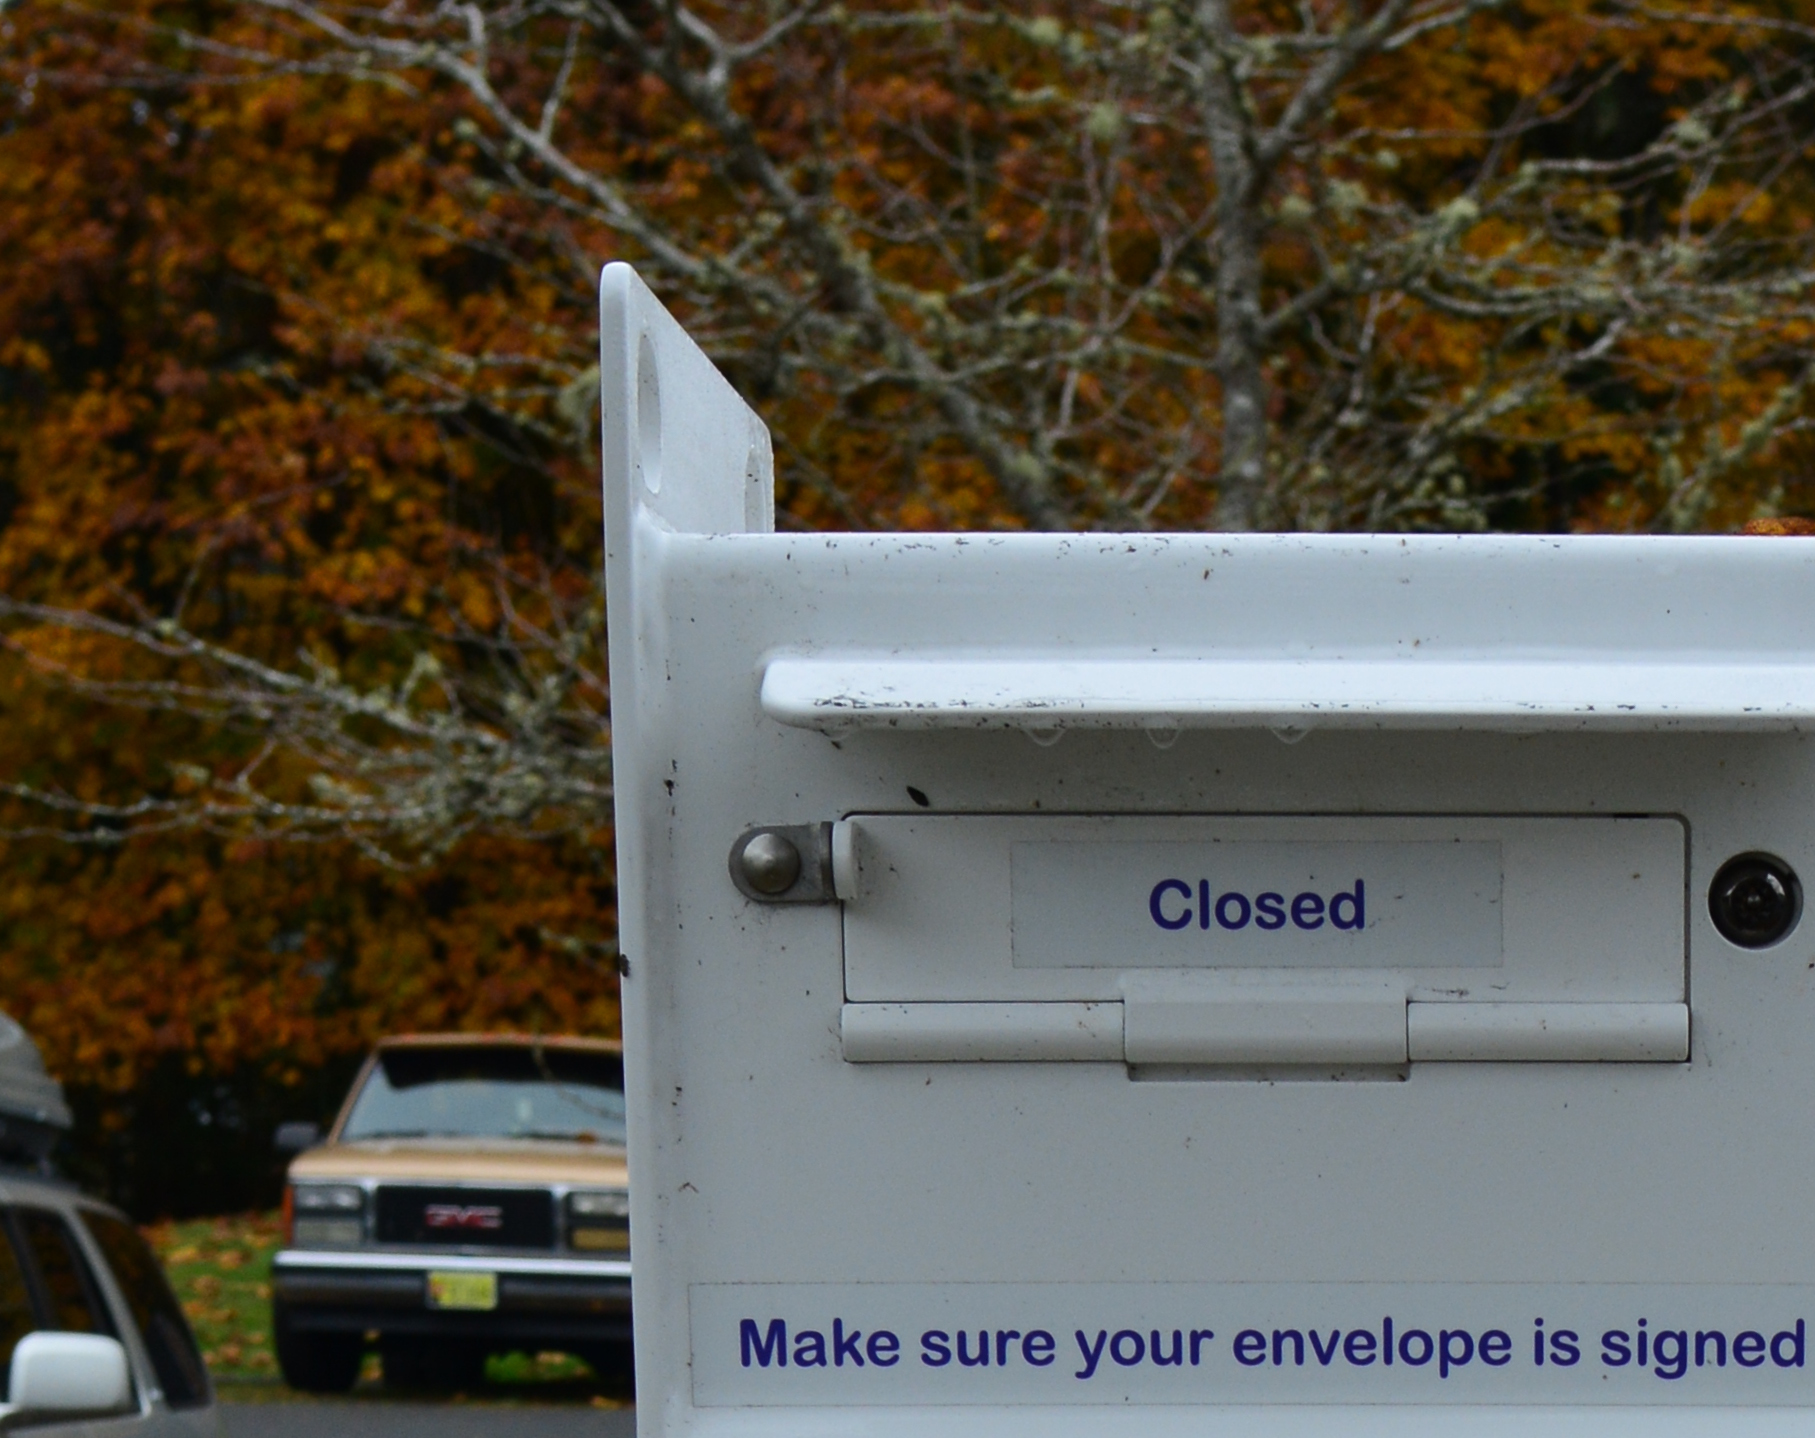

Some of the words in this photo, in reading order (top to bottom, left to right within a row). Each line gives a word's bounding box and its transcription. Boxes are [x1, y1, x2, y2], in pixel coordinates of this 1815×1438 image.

[1150, 879, 1364, 929] Closed
[740, 1318, 899, 1367] Make
[921, 1330, 1055, 1367] sure
[1075, 1330, 1214, 1379] your
[1233, 1316, 1511, 1378] envelope
[1535, 1318, 1581, 1367] is
[1601, 1318, 1806, 1379] signed
